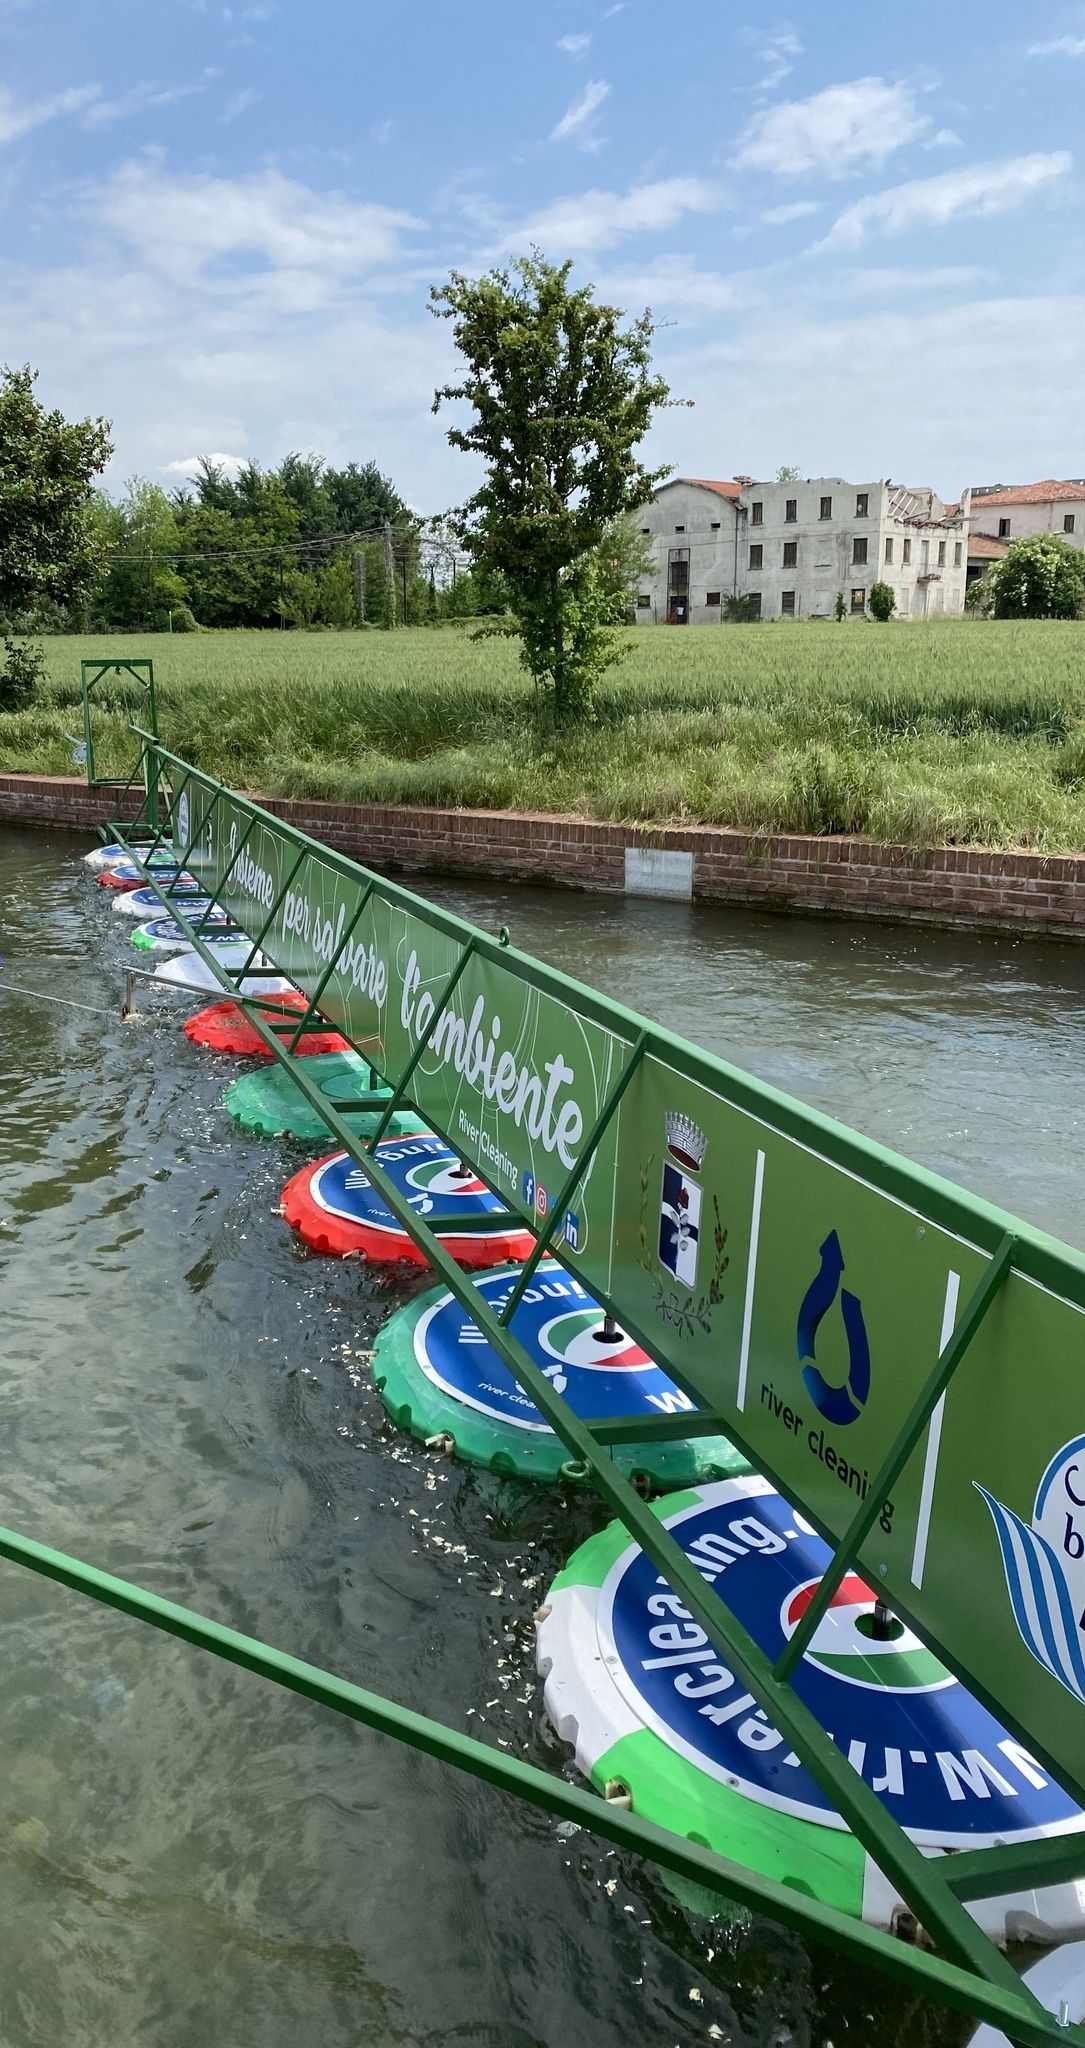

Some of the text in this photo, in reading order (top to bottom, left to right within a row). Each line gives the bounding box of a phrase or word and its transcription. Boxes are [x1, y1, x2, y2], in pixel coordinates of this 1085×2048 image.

[282, 890, 309, 943] per
[312, 903, 388, 1009] salvare
[458, 1109, 479, 1145] River
[481, 1129, 518, 1190] Cleaning
[478, 1383, 509, 1396] river
[760, 1382, 895, 1534] river cleanig
